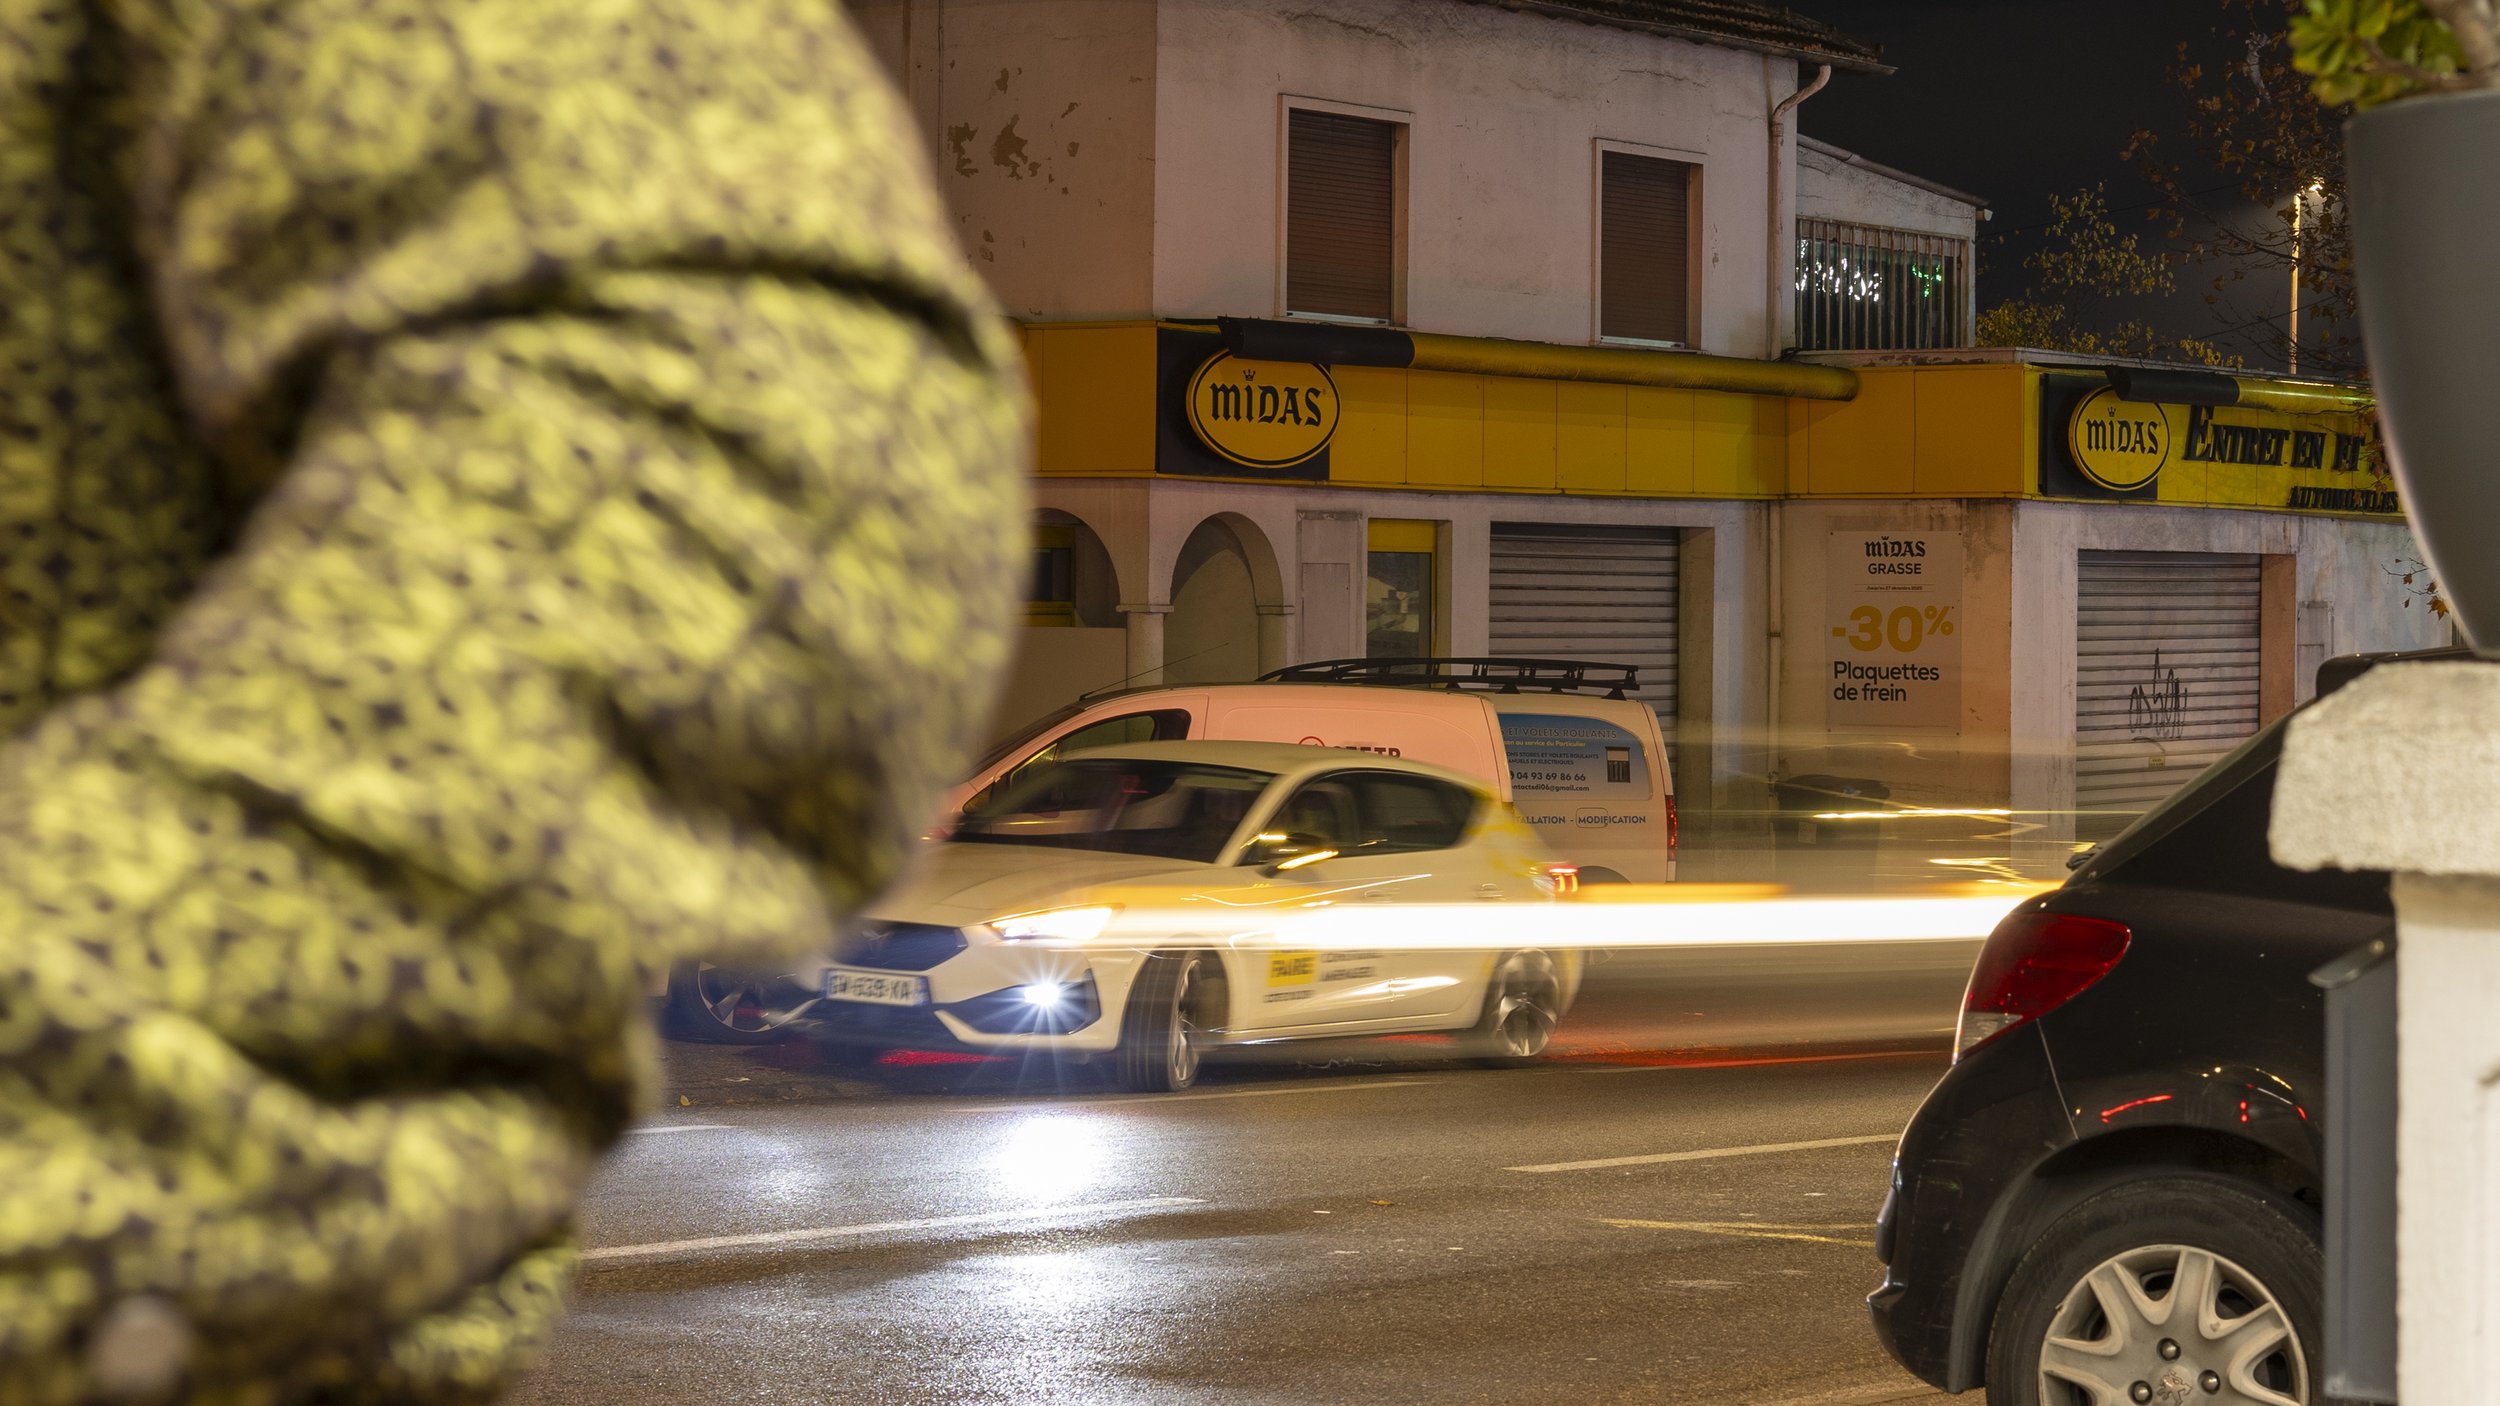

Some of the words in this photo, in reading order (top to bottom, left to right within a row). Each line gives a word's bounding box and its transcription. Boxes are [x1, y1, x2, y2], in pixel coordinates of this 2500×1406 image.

[1868, 563, 1922, 575] GRASSE
[1832, 605, 1954, 653] -30%
[1834, 661, 1940, 685] Plaquettes
[1834, 682, 1858, 701] de
[1862, 682, 1907, 701] frein
[1508, 727, 1520, 736] ET
[1523, 728, 1560, 738] VOLETS
[1563, 729, 1617, 739] ROULANTS
[1517, 772, 1529, 780] 04
[1531, 772, 1543, 780] 93
[1545, 772, 1558, 781] 69
[1560, 773, 1572, 781] 86
[1574, 773, 1586, 781] 66
[1578, 815, 1647, 825] MODIFICATION
